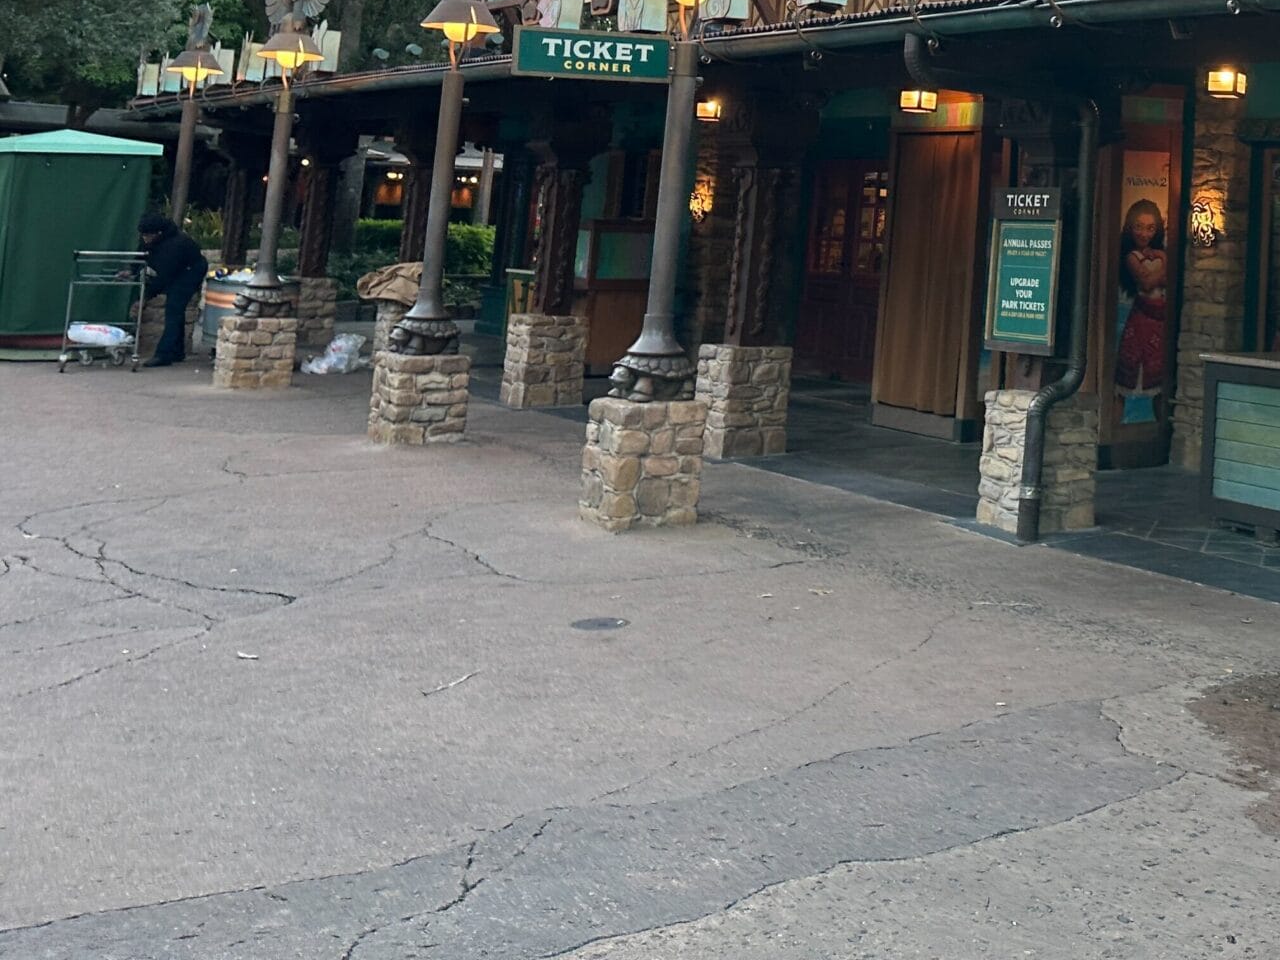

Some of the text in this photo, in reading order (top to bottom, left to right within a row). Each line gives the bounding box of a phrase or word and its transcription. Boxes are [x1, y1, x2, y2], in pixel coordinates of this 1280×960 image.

[541, 37, 655, 62] TICKET
[564, 60, 632, 73] CORNER
[1006, 194, 1049, 207] TICKET
[1003, 239, 1052, 248] ANNUAL PASSES
[1010, 278, 1040, 287] UPGRADE
[1015, 289, 1033, 298] YOUR
[1001, 300, 1045, 311] PARK TICKETS
